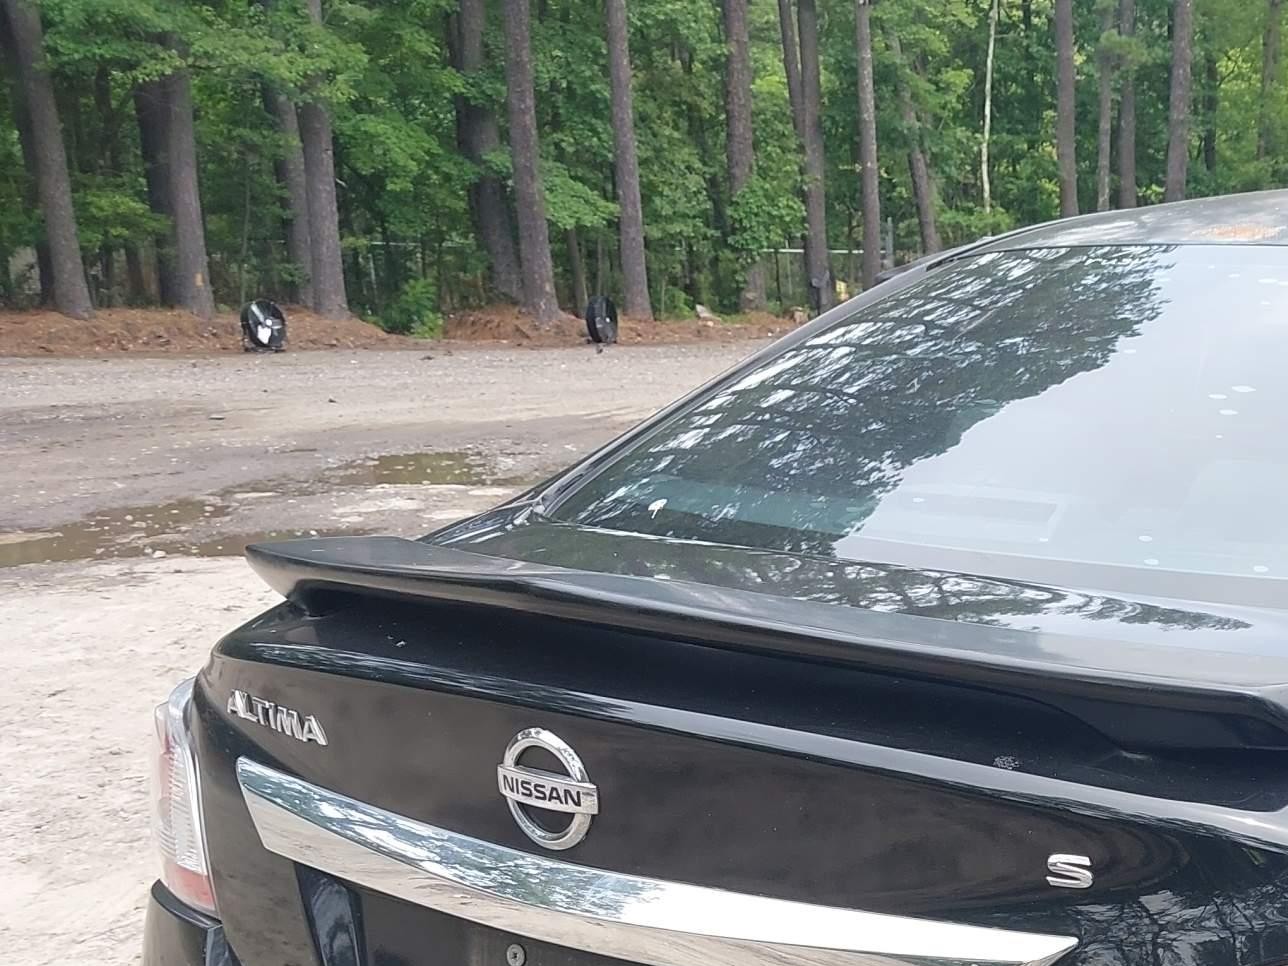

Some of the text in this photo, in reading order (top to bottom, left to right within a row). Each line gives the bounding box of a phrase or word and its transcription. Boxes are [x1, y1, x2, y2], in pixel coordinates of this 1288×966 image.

[226, 688, 329, 747] ALTIMA
[501, 773, 583, 808] NISSAN
[1045, 853, 1094, 889] S
